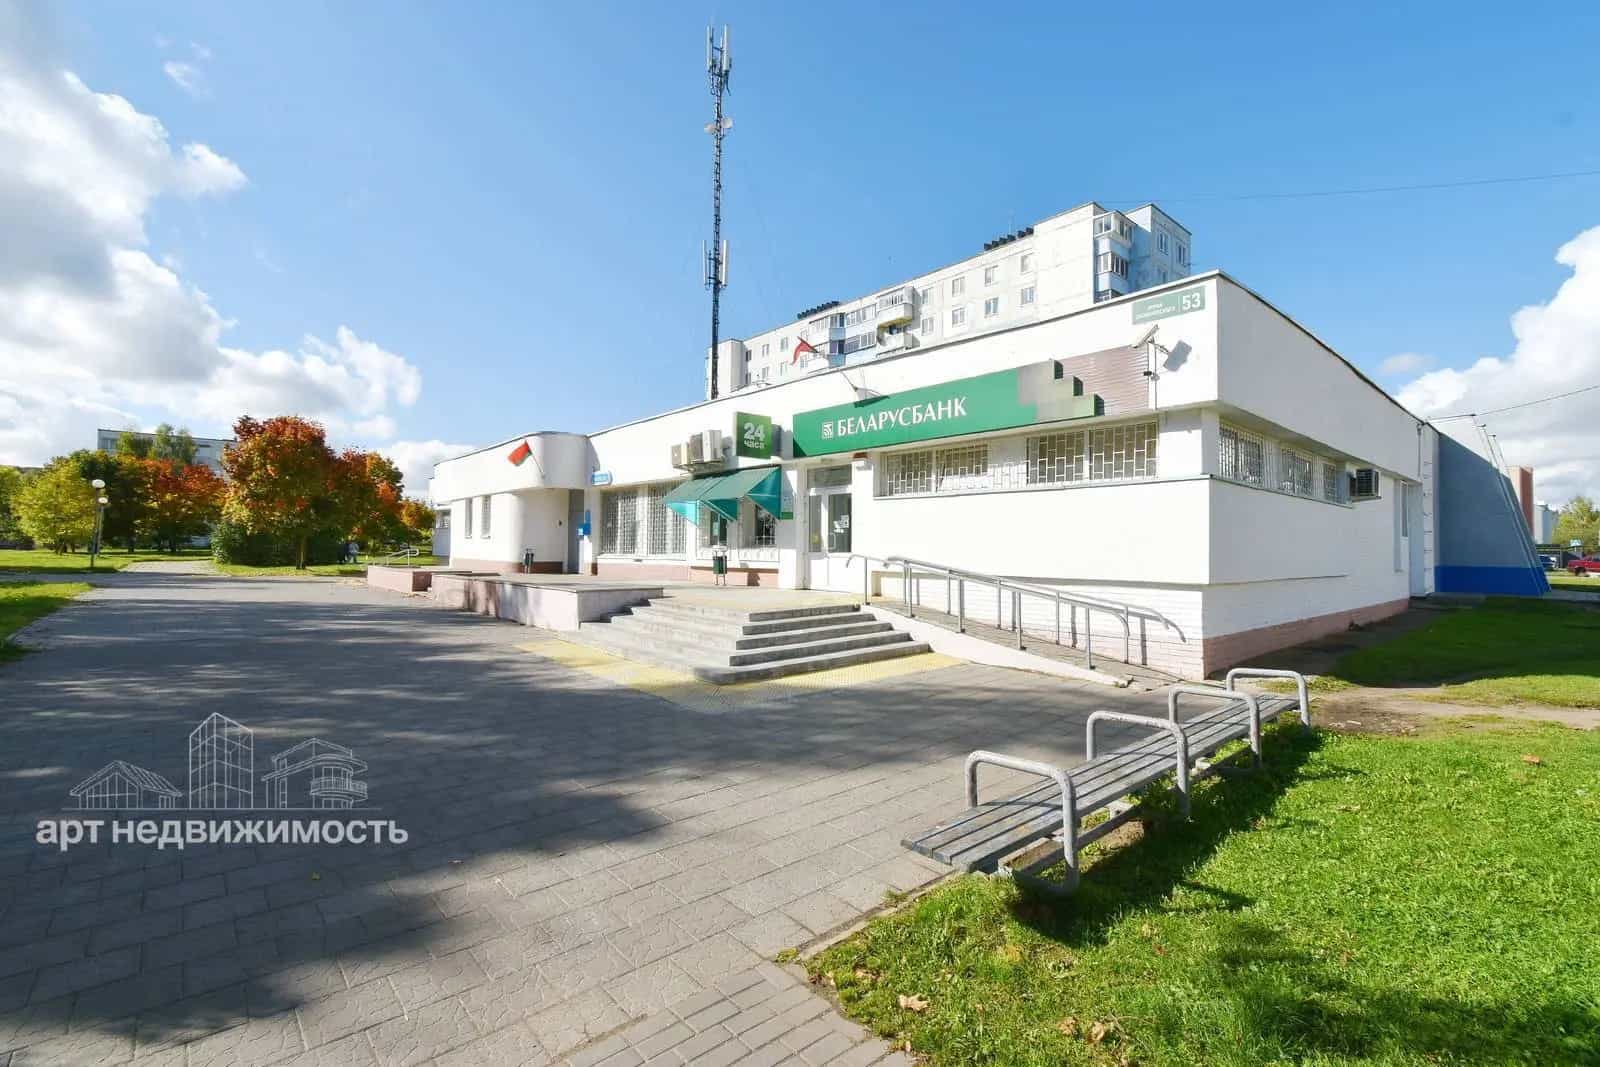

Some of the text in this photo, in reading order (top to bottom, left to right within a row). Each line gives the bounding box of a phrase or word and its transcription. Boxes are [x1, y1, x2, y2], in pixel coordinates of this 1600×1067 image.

[1182, 292, 1201, 311] 53
[837, 396, 967, 436] БЕЛАРУСБАНК
[743, 422, 765, 442] 24
[743, 439, 765, 449] часа
